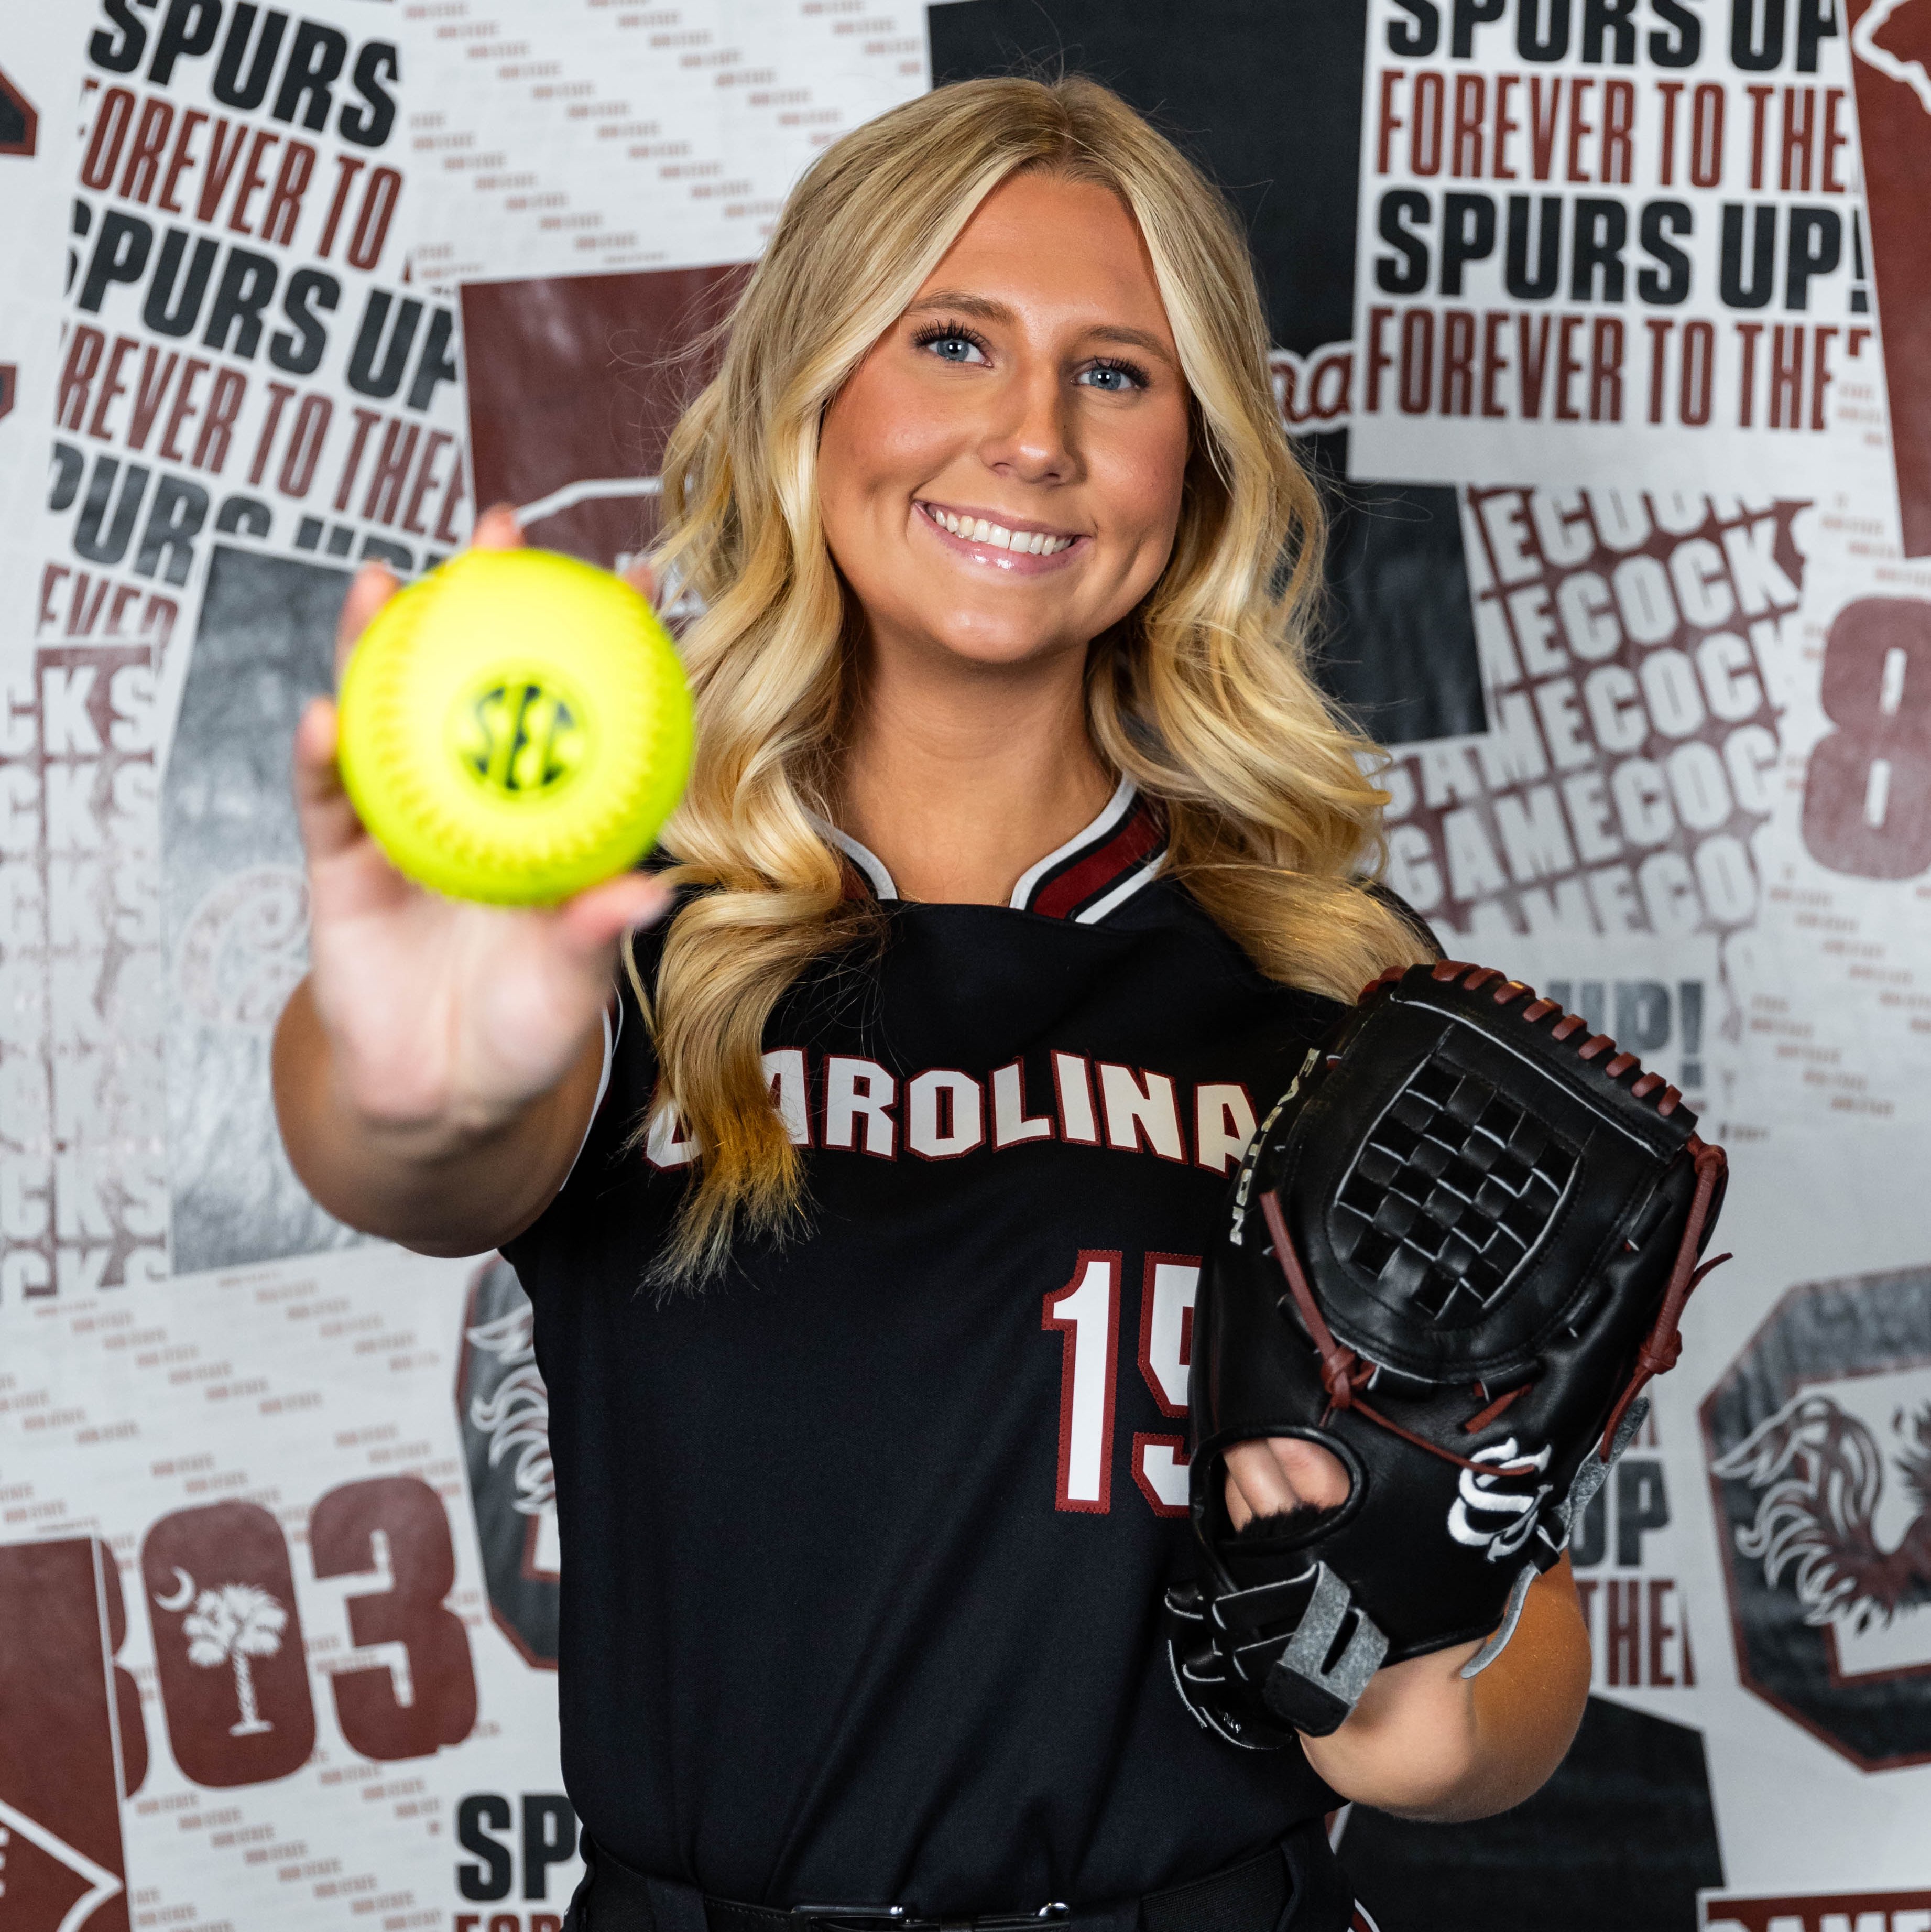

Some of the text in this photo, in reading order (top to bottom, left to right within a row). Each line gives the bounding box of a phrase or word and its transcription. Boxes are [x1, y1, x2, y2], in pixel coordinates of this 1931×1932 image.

[88, 0, 400, 147] SPURS
[1376, 70, 1848, 193] FOREVER TO THE
[317, 155, 402, 272] TO
[1374, 189, 1693, 306] SPURS
[56, 320, 247, 473] REVER
[248, 381, 334, 499] TO
[1363, 307, 1623, 424] FOREVER
[1646, 318, 1715, 426] TO
[1734, 323, 1872, 431] THE
[1230, 1048, 1321, 1246] EASTON
[1041, 1249, 1204, 1518] 15
[101, 1471, 478, 1801] 03
